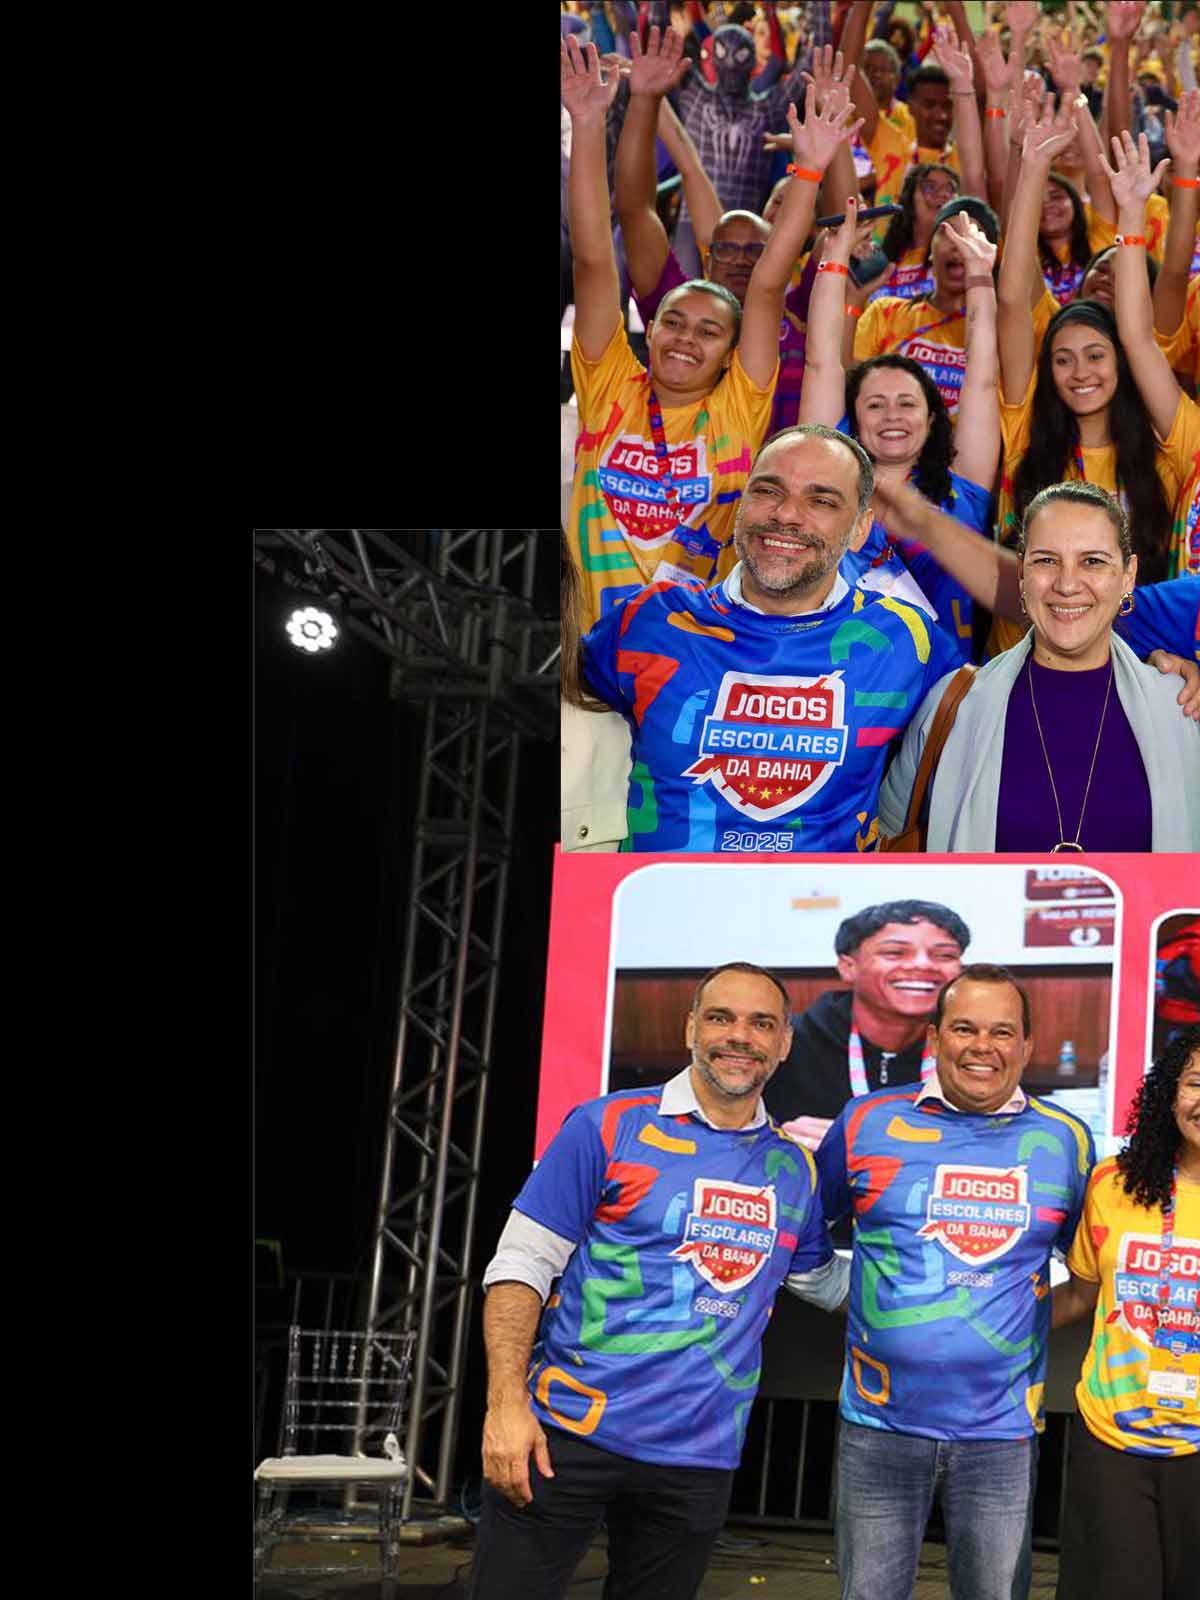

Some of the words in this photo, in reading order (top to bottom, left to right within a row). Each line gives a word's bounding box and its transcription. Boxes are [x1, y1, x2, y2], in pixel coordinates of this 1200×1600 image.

[612, 449, 692, 475] JOGS
[613, 499, 631, 514] DA
[730, 693, 827, 721] JOGOS
[707, 729, 839, 754] ESCOLARES
[726, 759, 750, 776] DA
[757, 761, 812, 781] BAHIA
[721, 831, 793, 852] 2025
[945, 1178, 1015, 1199] JOGOS
[704, 1195, 767, 1222] JOGOS
[932, 1203, 1024, 1222] ESCOLARES
[691, 1223, 771, 1248] ESCOLARES
[946, 1223, 964, 1235] DA
[969, 1225, 1008, 1239] BAHIA
[702, 1245, 719, 1260] DA
[722, 1248, 757, 1265] BAHIA
[694, 1296, 739, 1318] 2025
[1133, 1305, 1154, 1320] DA
